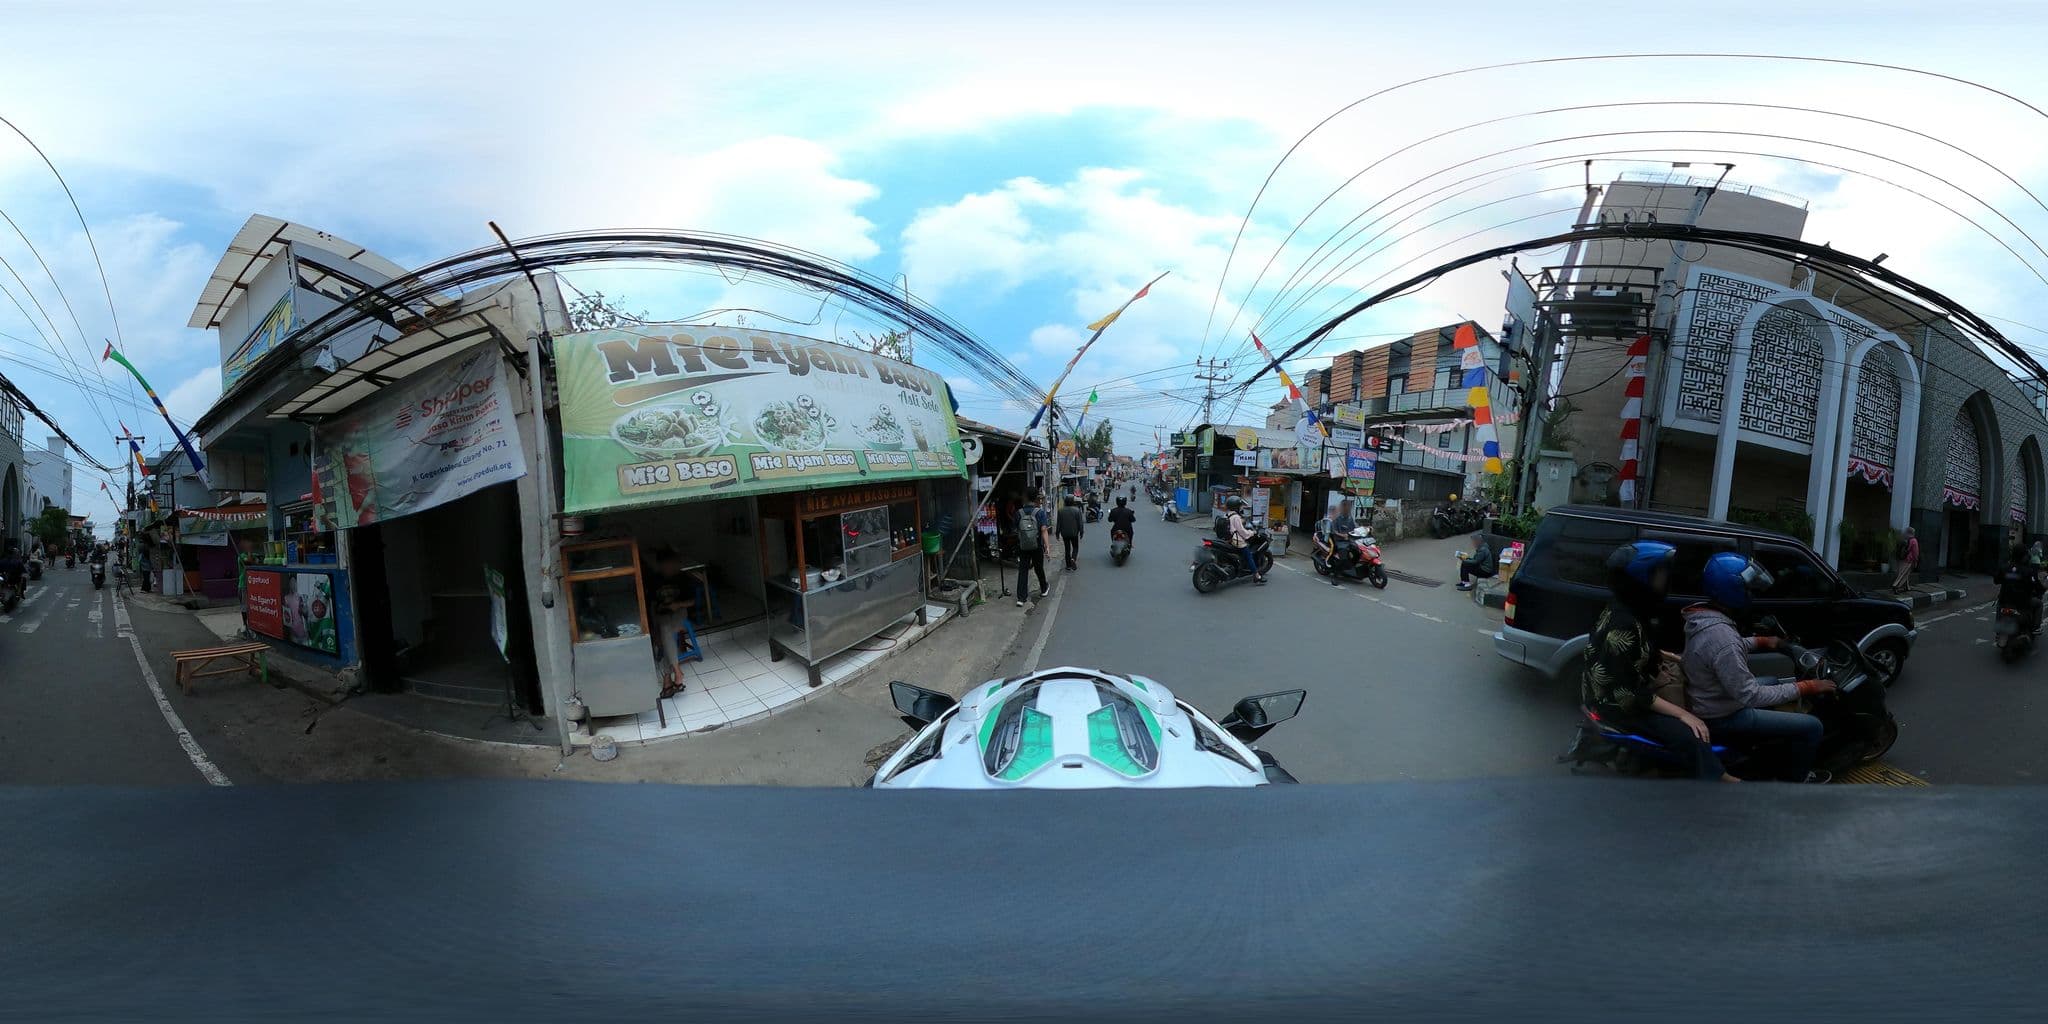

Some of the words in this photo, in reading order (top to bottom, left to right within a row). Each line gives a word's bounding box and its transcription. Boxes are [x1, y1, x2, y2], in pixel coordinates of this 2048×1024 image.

[597, 333, 749, 383] Mie
[750, 336, 869, 379] Ayam
[872, 359, 932, 396] Baso
[420, 375, 496, 418] Shipper
[898, 390, 919, 407] Asli
[752, 454, 782, 471] Mie
[786, 453, 826, 472] Ayam
[826, 452, 855, 467] Baso
[866, 451, 885, 465] Mie
[886, 452, 910, 466] Ayam
[623, 464, 671, 488] Mie
[674, 459, 734, 482] Baso
